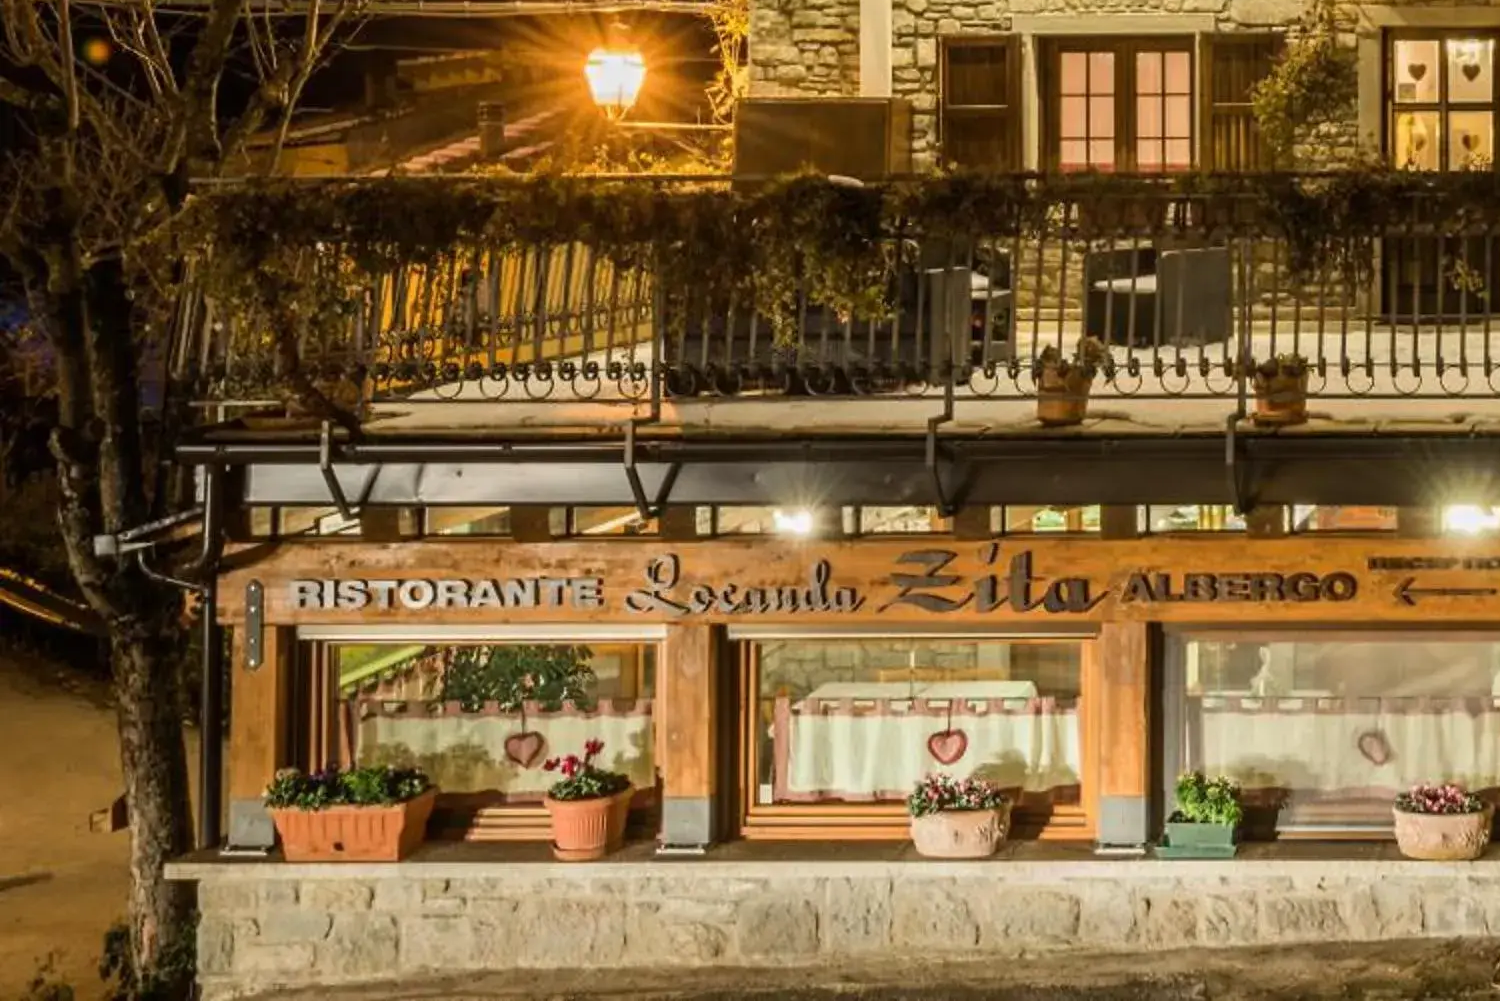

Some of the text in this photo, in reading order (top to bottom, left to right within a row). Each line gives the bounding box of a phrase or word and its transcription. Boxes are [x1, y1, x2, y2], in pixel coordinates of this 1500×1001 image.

[288, 542, 1358, 615] RISTORANTE Locanda Zita ALBERGO
